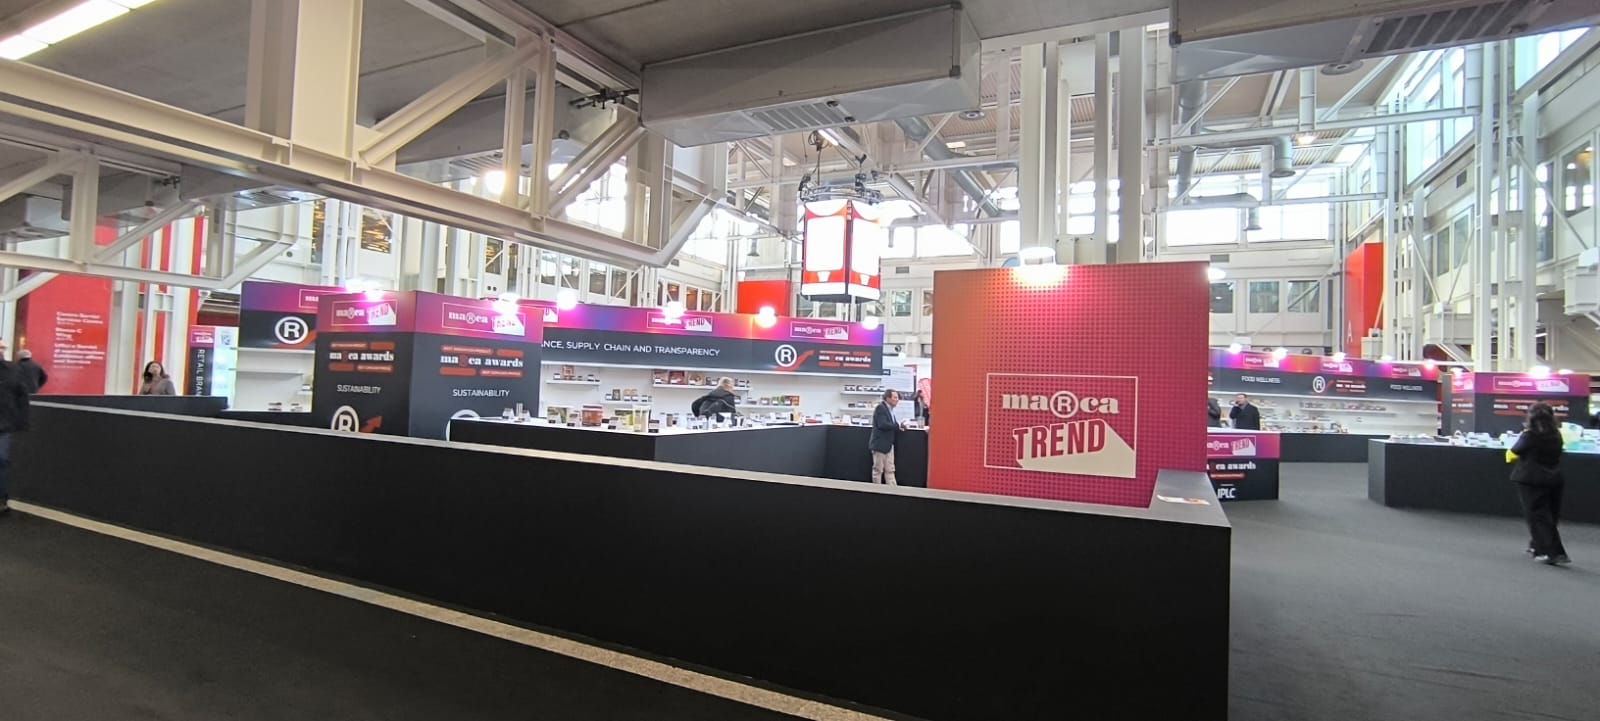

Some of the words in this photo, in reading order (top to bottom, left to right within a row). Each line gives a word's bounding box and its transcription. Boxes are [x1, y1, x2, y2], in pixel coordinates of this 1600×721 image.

[566, 341, 601, 350] SUPPLY
[603, 343, 631, 352] CHAIN
[633, 344, 652, 353] AND
[654, 346, 720, 357] TRANSPARENCY
[360, 351, 394, 361] awards
[485, 357, 524, 368] awards
[336, 384, 381, 394] SUSTAINABILITY
[452, 389, 510, 398] SUSTAINABILITY
[1013, 418, 1107, 462] TREND
